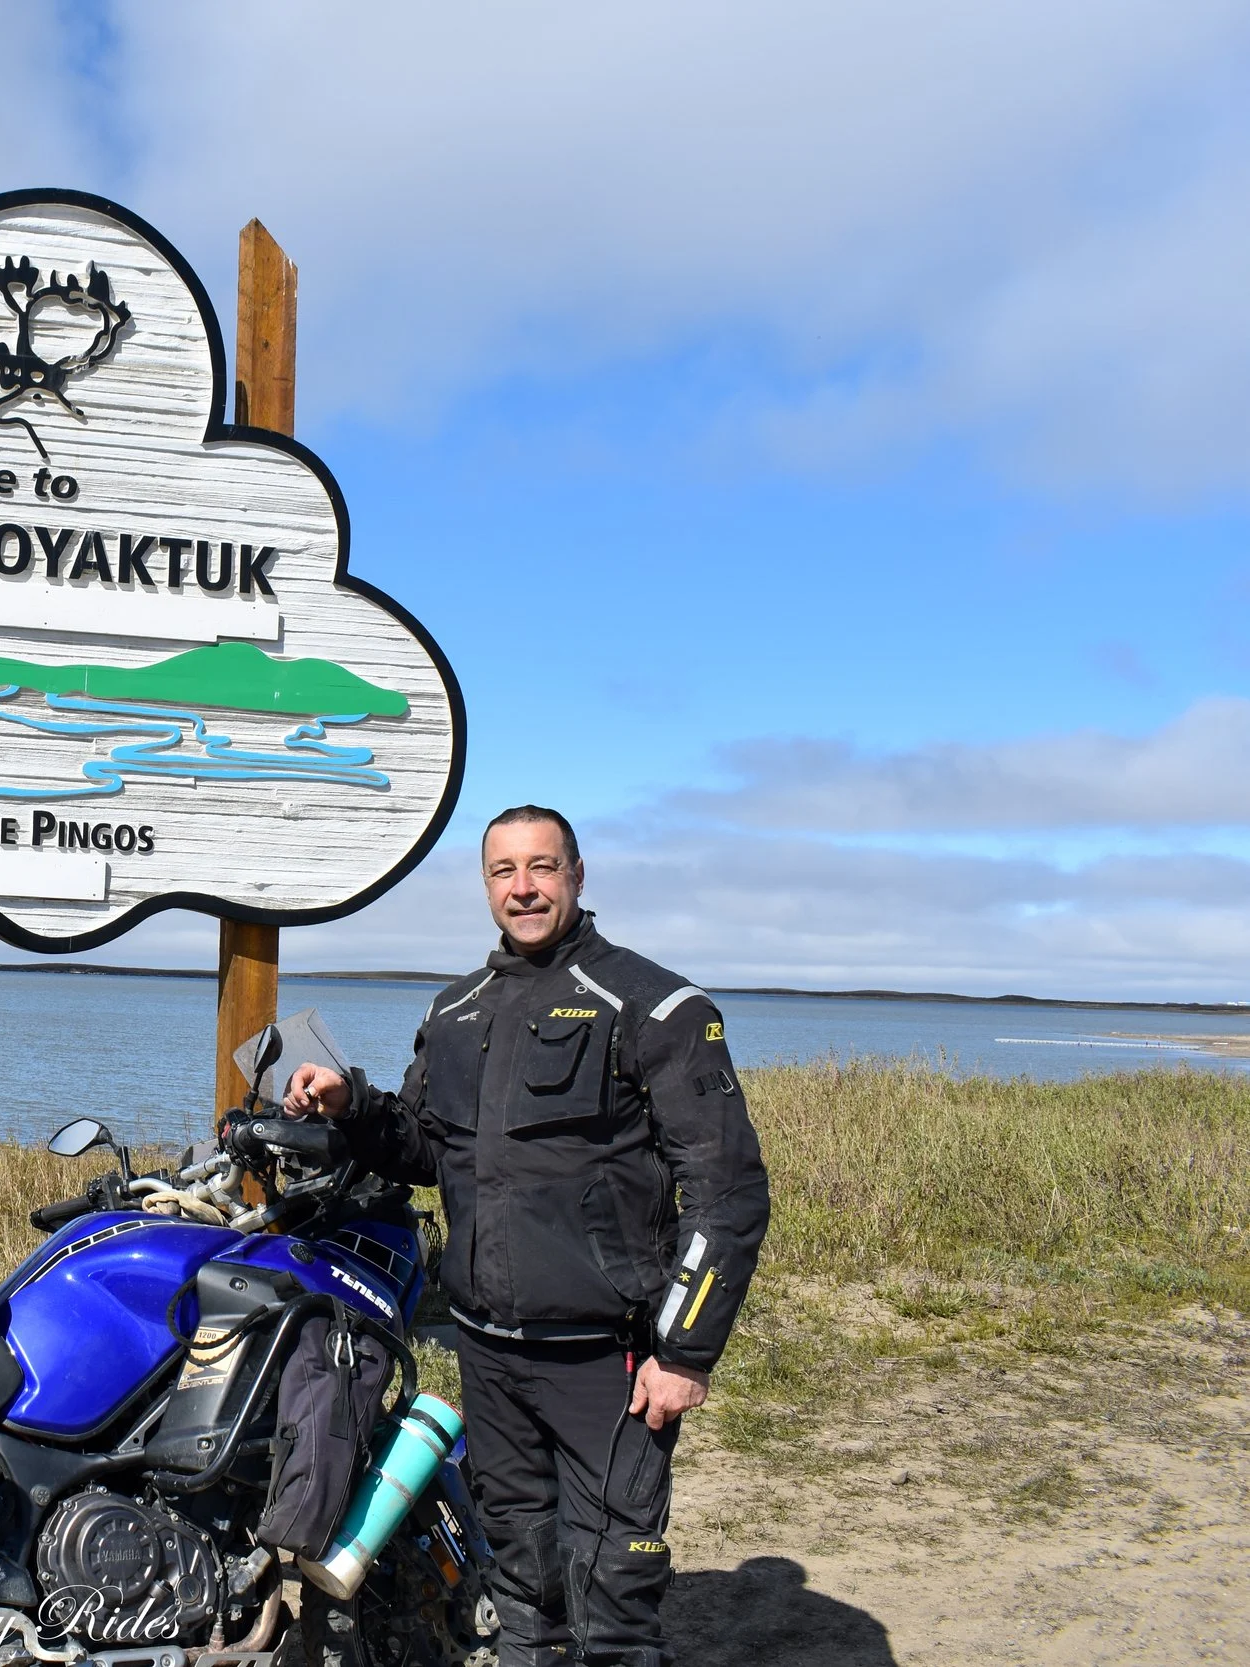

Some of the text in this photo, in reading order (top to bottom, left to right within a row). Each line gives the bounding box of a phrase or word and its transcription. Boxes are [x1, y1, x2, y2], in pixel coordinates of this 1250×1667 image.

[33, 467, 78, 499] to
[199, 1331, 217, 1340] 1200
[102, 1549, 140, 1562] YAMAHA
